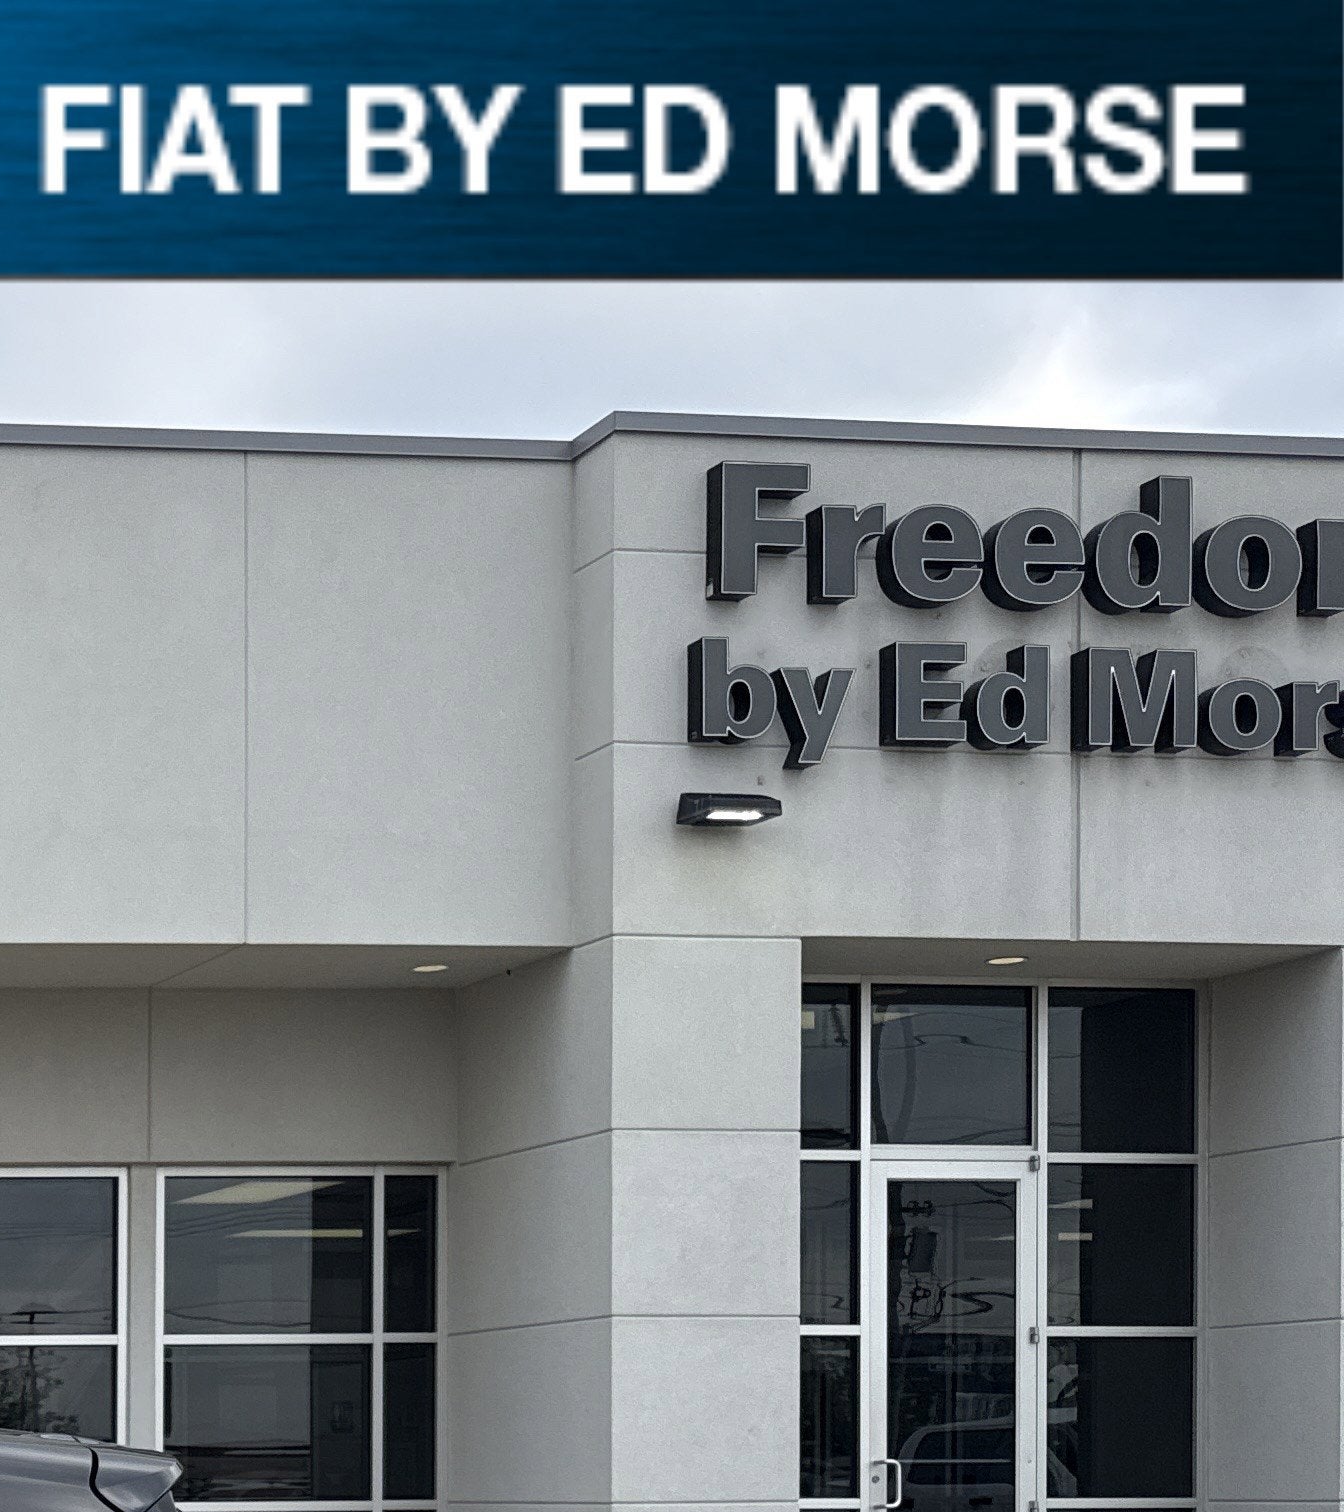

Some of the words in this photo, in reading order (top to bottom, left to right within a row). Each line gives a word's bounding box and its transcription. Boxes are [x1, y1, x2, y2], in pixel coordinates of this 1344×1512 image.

[706, 460, 1344, 617] Freedo
[687, 636, 856, 769] by
[879, 641, 1051, 751] Ed
